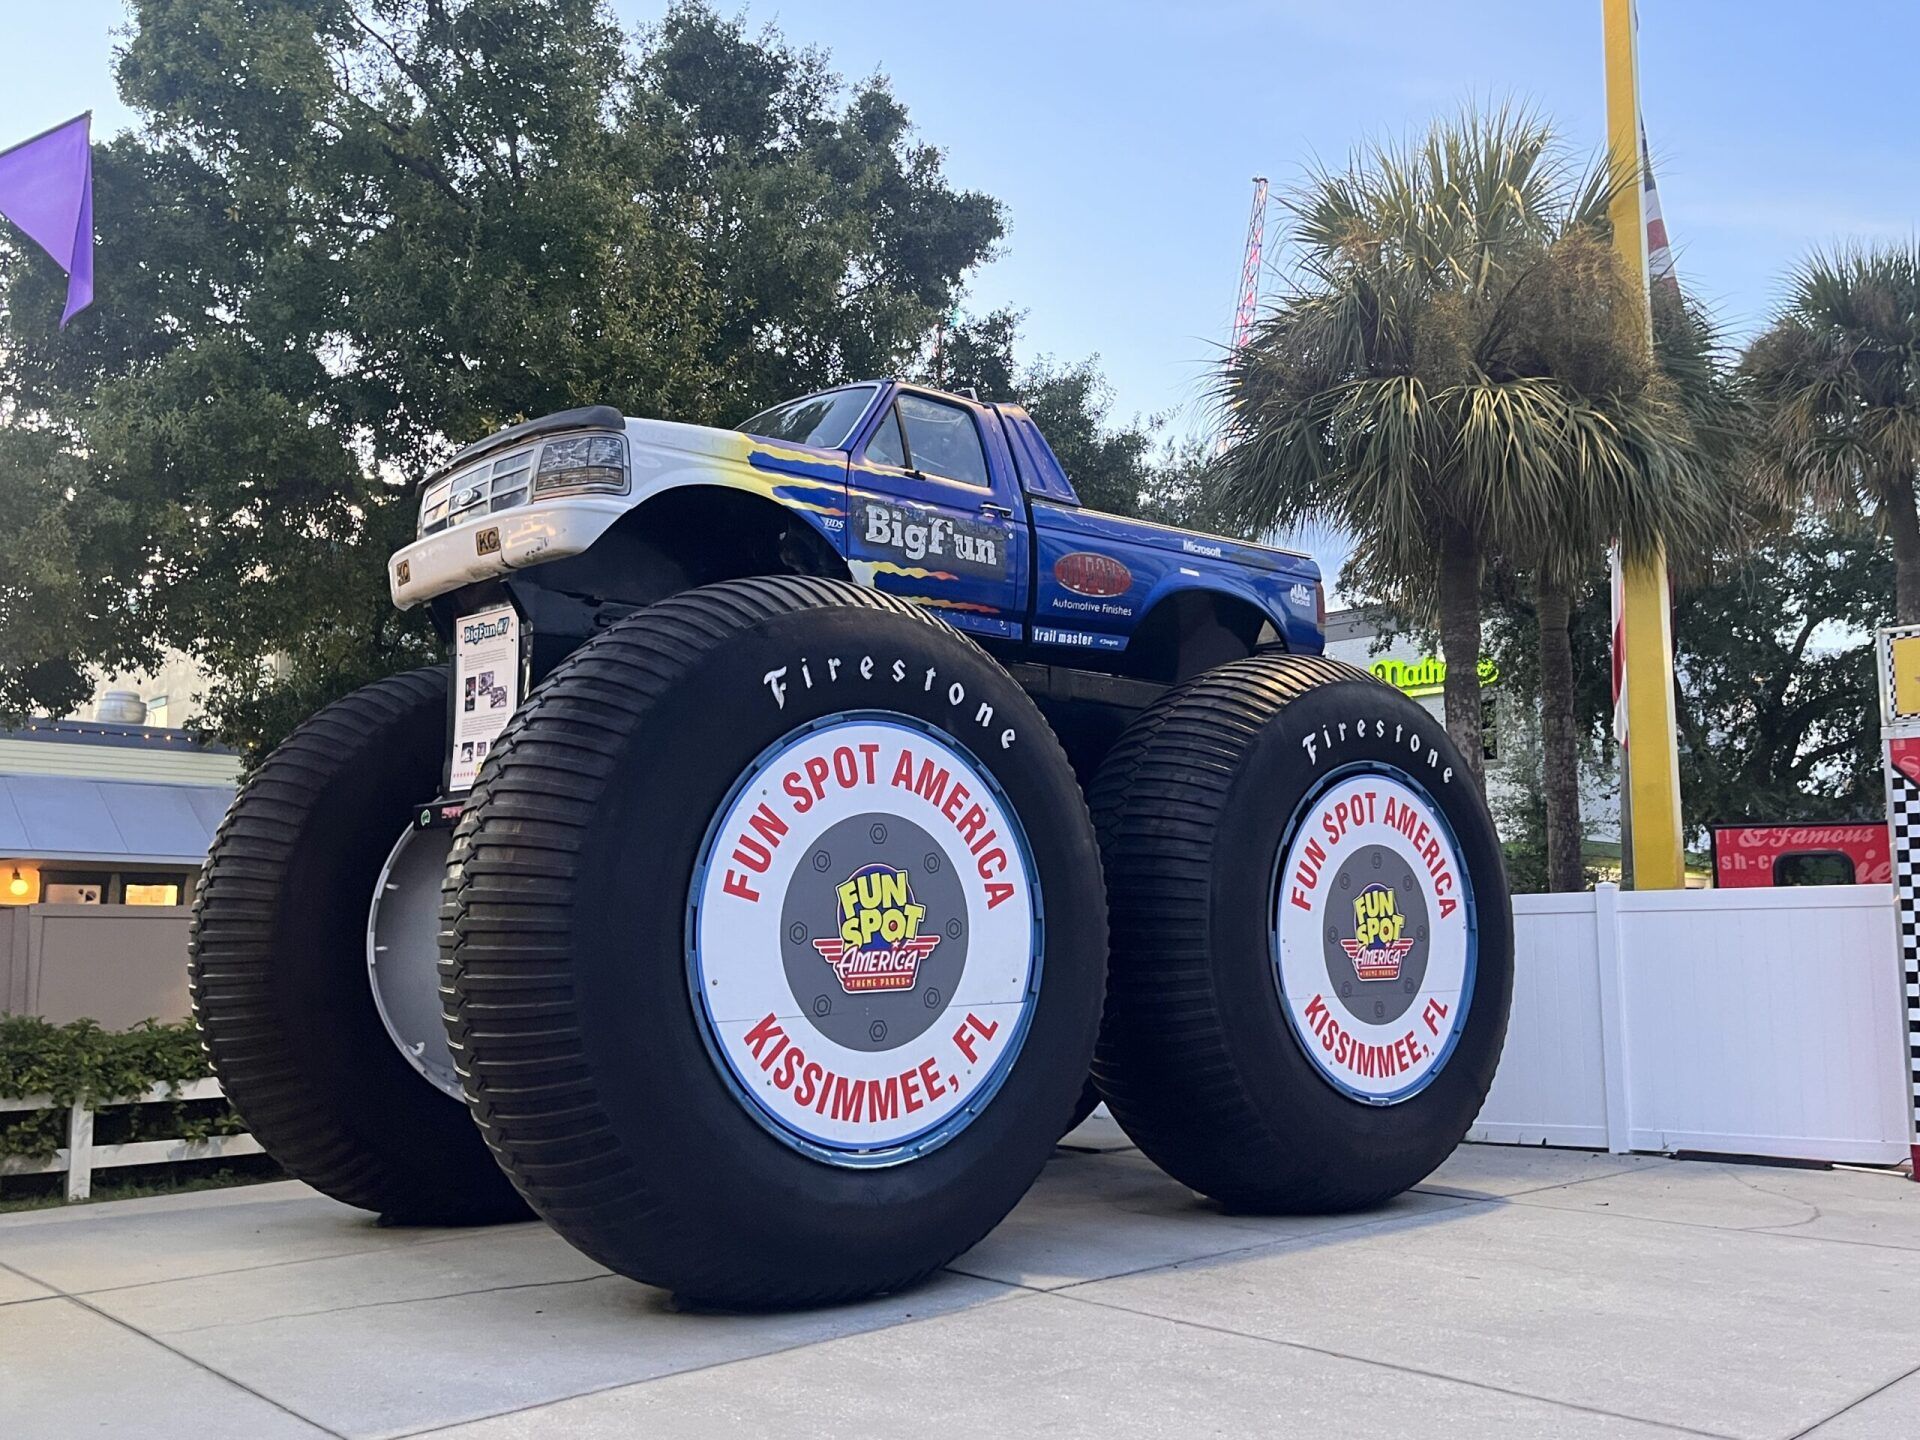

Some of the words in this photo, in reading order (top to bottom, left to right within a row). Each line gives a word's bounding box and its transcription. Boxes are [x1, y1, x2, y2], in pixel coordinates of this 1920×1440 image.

[865, 503, 997, 566] BigFun
[1182, 540, 1222, 558] Microsoft
[1052, 597, 1100, 612] Automotive
[1101, 603, 1132, 616] Finishes
[464, 622, 497, 645] BigFun
[1034, 627, 1057, 643] trail
[1058, 632, 1093, 646] master
[763, 655, 1016, 749] Firestone
[1302, 719, 1453, 783] Firestone
[722, 802, 790, 903] FUN
[782, 743, 880, 814] SPOT
[891, 749, 1016, 910] AMERICA
[1769, 827, 1875, 848] Famous
[1290, 836, 1327, 912] FUN
[1322, 792, 1377, 846] SPOT
[1383, 796, 1458, 920] AMERICA
[838, 872, 907, 919] FUN
[1355, 890, 1394, 925] FUN
[841, 903, 924, 952] SPOT
[1356, 914, 1404, 949] SPOT
[837, 945, 919, 979] AMERICA
[1354, 945, 1401, 969] AMERICA
[1304, 993, 1429, 1079] KISSIMMEE,
[1422, 997, 1449, 1037] FL
[743, 1011, 959, 1124] KISSIMMEE,
[952, 1012, 999, 1065] FL
